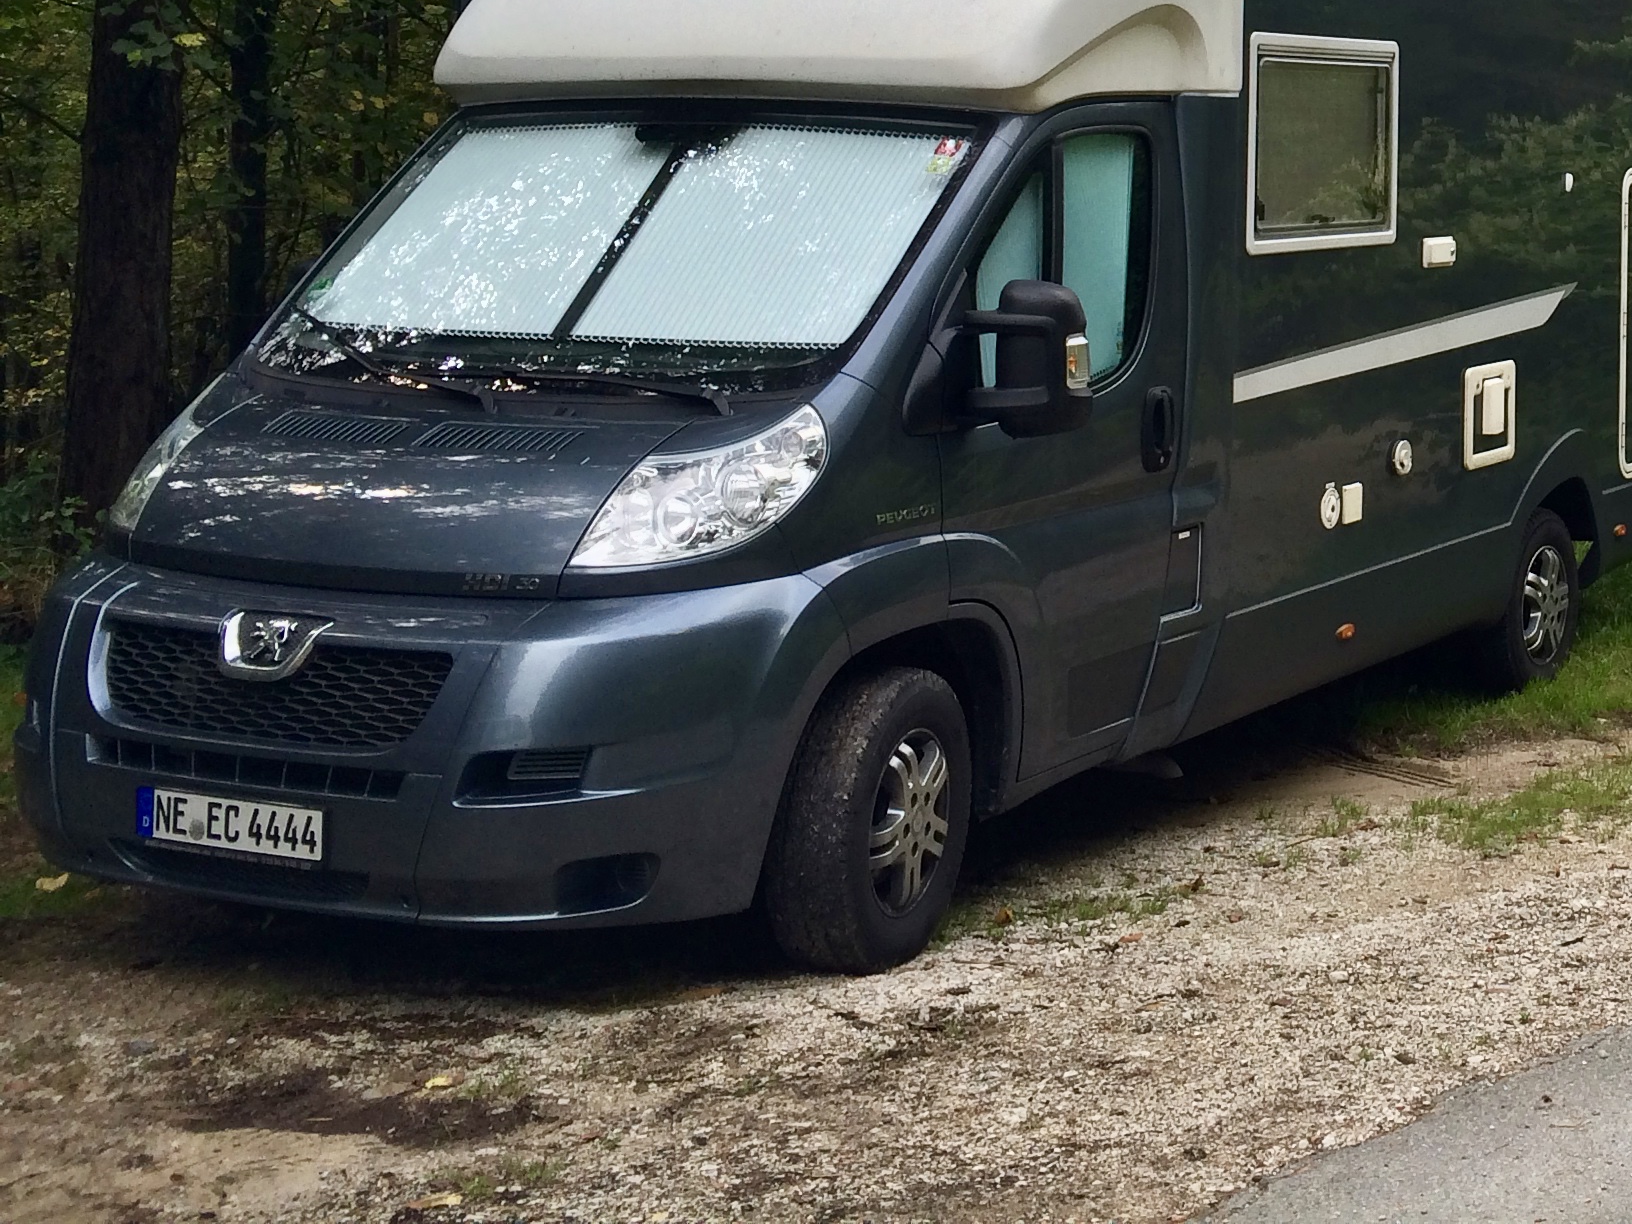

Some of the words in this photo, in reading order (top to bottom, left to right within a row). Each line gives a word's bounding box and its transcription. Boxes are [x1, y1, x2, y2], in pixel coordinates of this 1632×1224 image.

[876, 503, 936, 525] PEUGEOT
[142, 816, 149, 827] D
[156, 794, 188, 836] NE
[207, 802, 240, 843] EC
[248, 808, 317, 854] 4444
